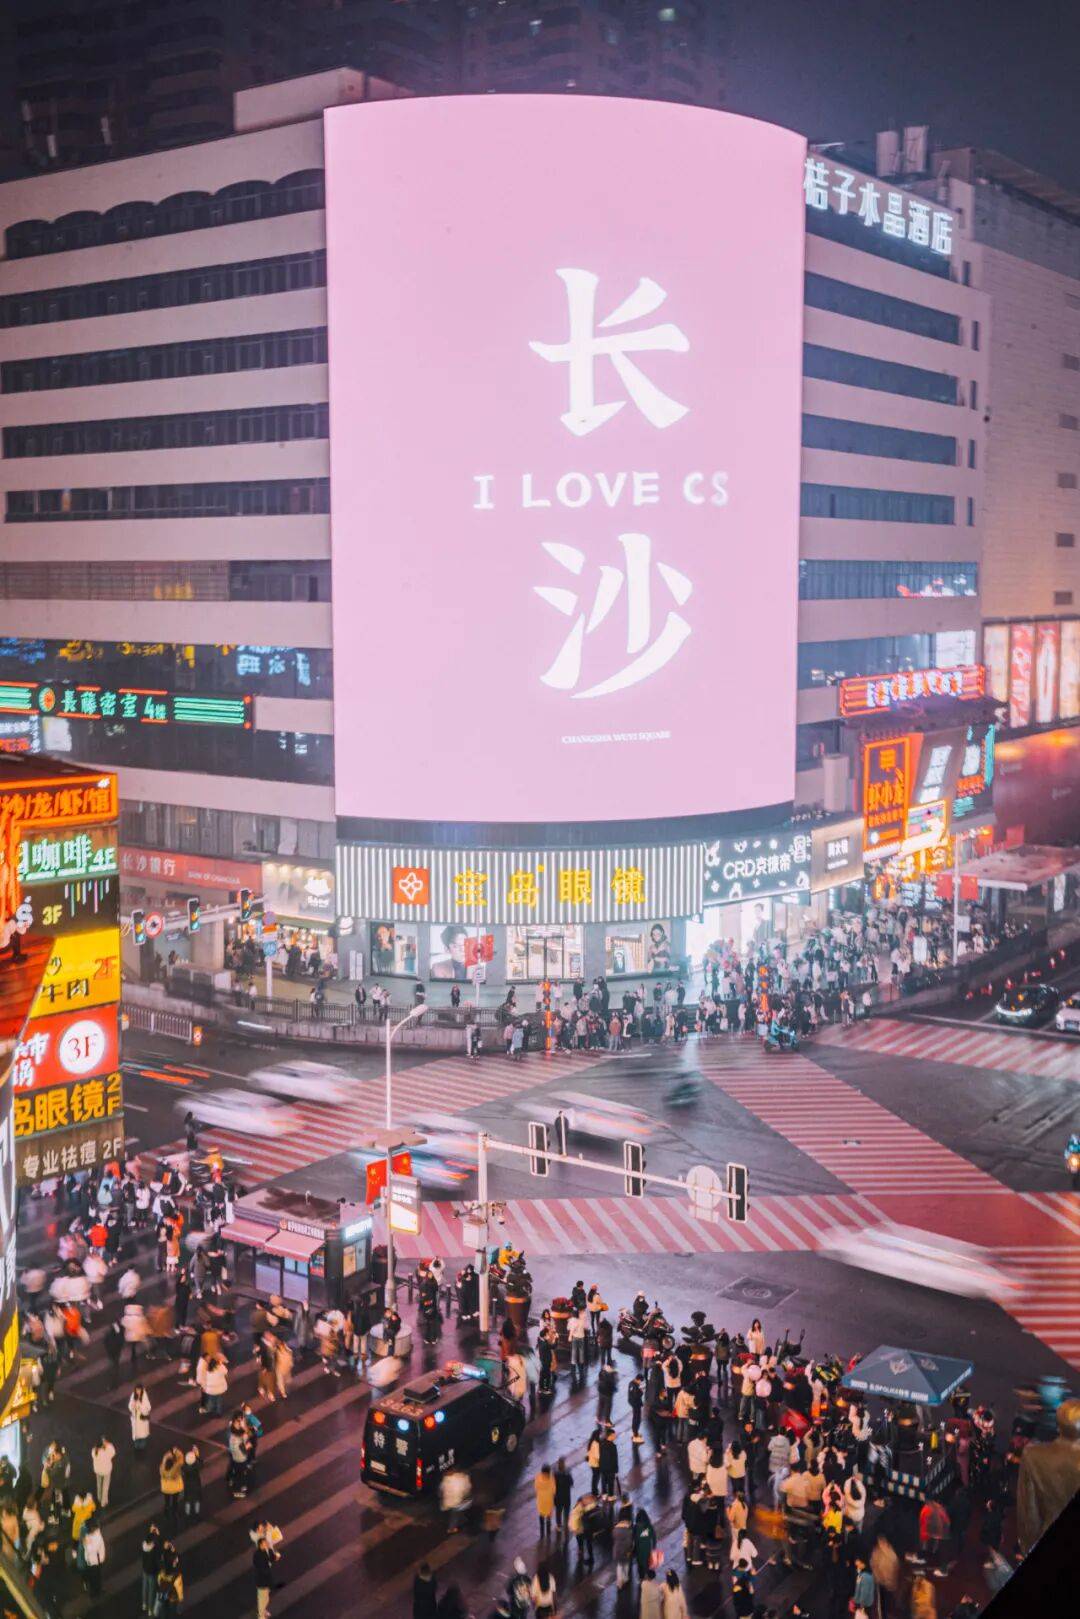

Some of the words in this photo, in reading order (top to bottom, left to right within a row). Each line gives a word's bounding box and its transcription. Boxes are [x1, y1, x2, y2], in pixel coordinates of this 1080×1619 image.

[528, 267, 690, 437] 长
[473, 474, 495, 509] I
[522, 471, 661, 508] LOVE
[683, 471, 729, 507] CS
[532, 532, 693, 699] 沙
[121, 853, 177, 876] 长沙银行
[42, 904, 63, 926] 3F
[102, 1137, 122, 1160] 2F
